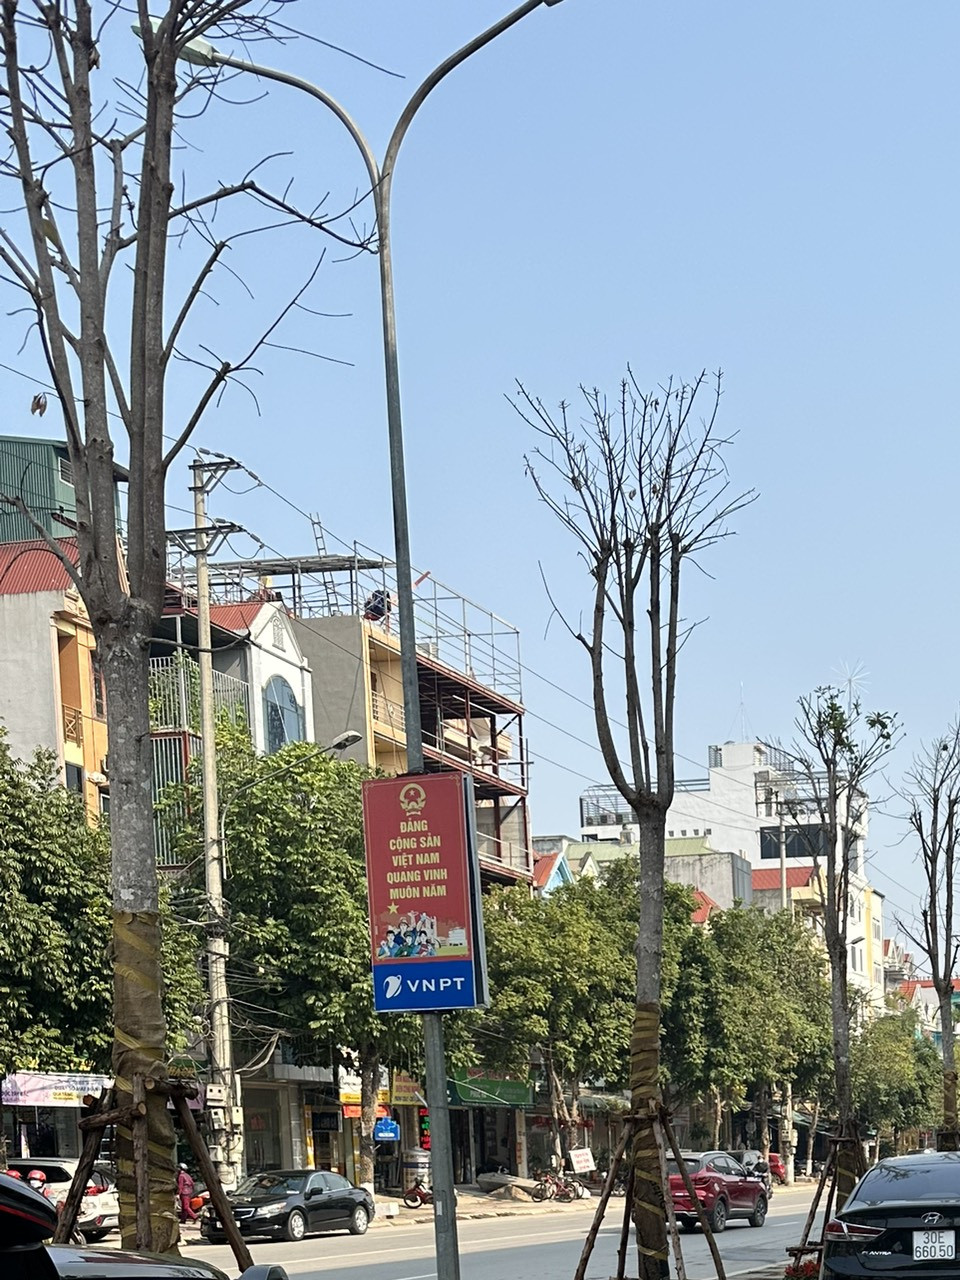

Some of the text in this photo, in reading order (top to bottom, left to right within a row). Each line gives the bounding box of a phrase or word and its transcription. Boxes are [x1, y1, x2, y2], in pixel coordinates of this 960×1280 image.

[400, 818, 428, 833] ĐẢNG
[389, 832, 441, 851] CỘNG SẢN
[392, 852, 440, 869] VIỆT NAM
[386, 868, 448, 885] QUANG VINH
[389, 883, 447, 900] MUÔN NĂM
[407, 977, 465, 993] VNPT
[922, 1231, 945, 1244] 30E
[914, 1244, 954, 1258] 660.50
